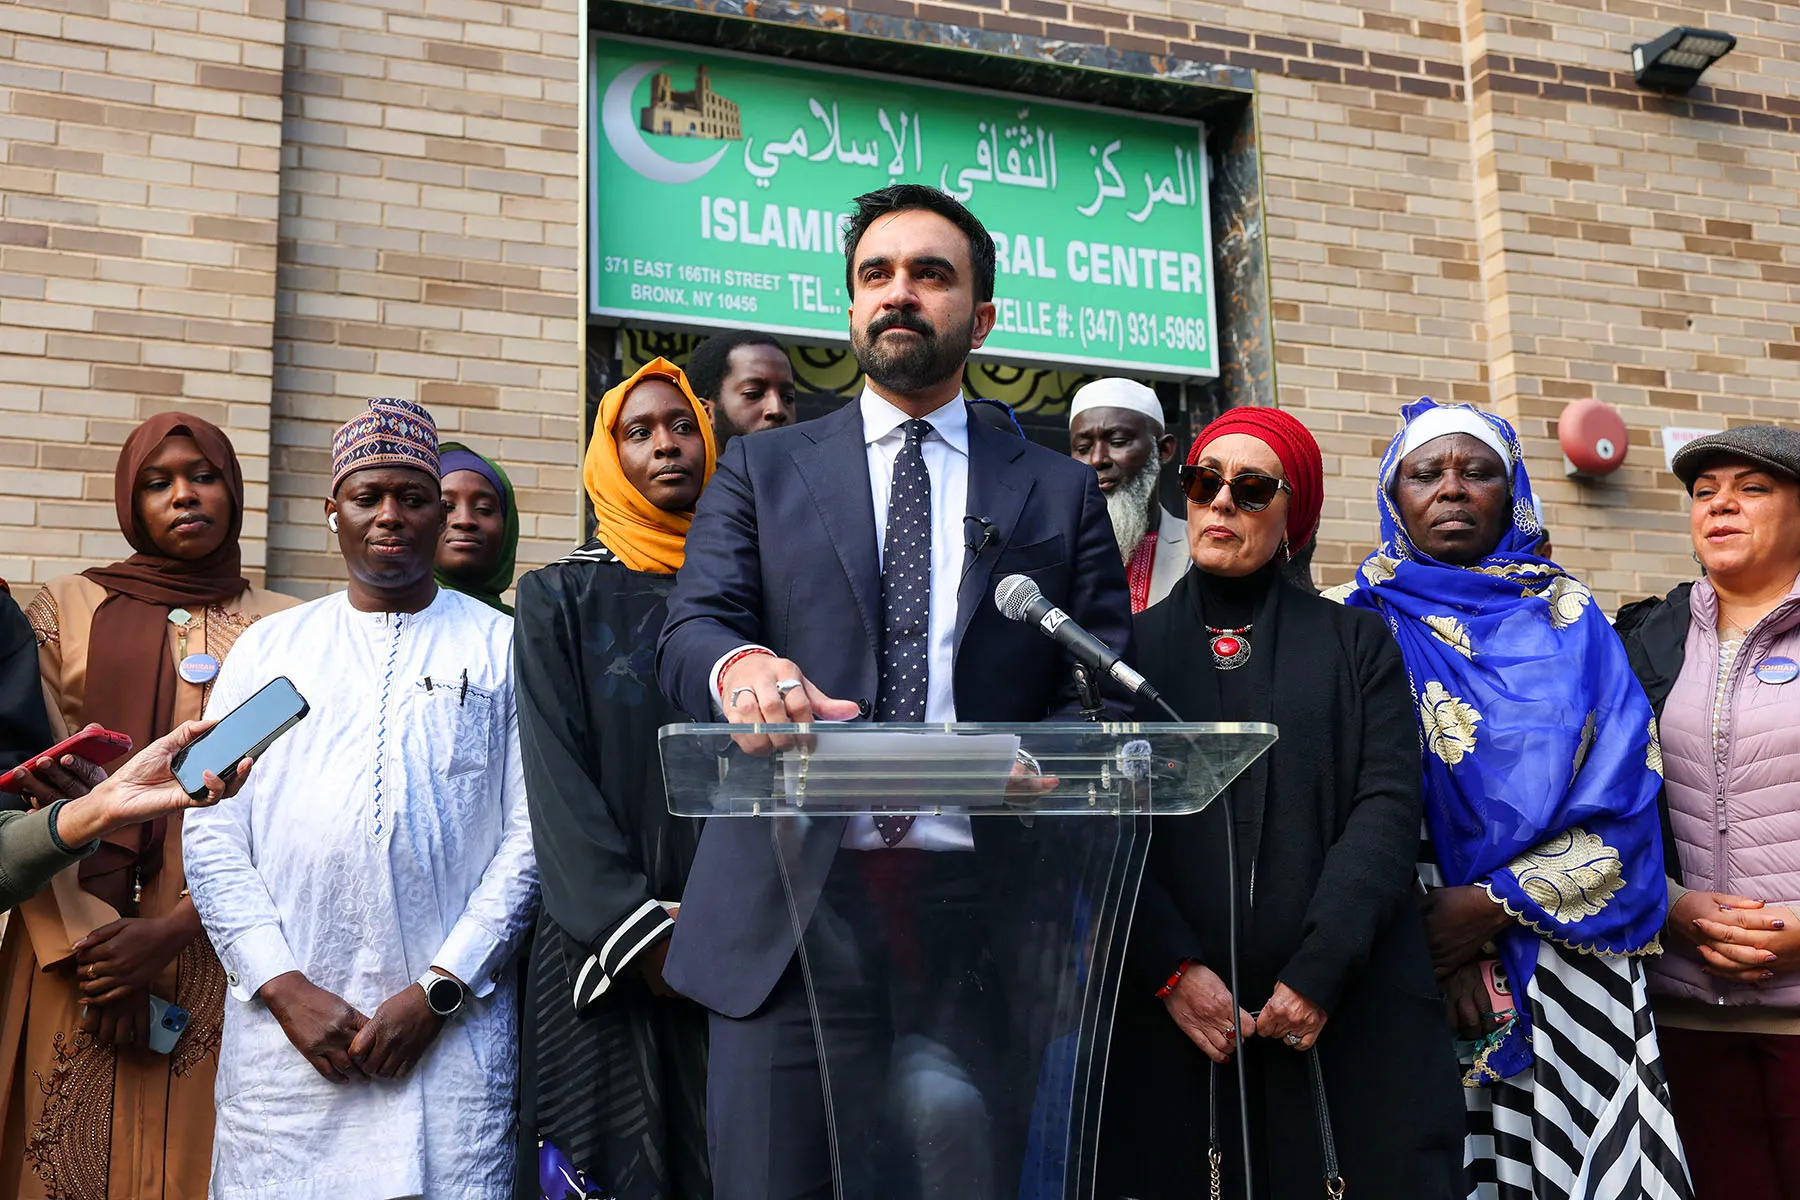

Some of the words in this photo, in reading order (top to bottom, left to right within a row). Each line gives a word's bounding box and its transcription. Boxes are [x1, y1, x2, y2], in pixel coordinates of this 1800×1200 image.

[743, 97, 922, 189] الإسلامي
[1076, 139, 1196, 223] المركز
[604, 256, 629, 274] 371
[633, 259, 673, 280] EAST
[677, 265, 721, 285] 166TH
[724, 270, 781, 292] STREET
[1066, 240, 1203, 294] CENTER
[631, 284, 689, 308] BRONX,
[692, 290, 714, 308] NY
[717, 293, 758, 313] 10456
[787, 272, 842, 314] TEL.:
[991, 297, 1053, 336] ZELLE
[1056, 303, 1075, 339] #:
[1079, 306, 1124, 352] (347)
[1127, 311, 1206, 352] 931-5968
[1044, 610, 1065, 629] Z4
